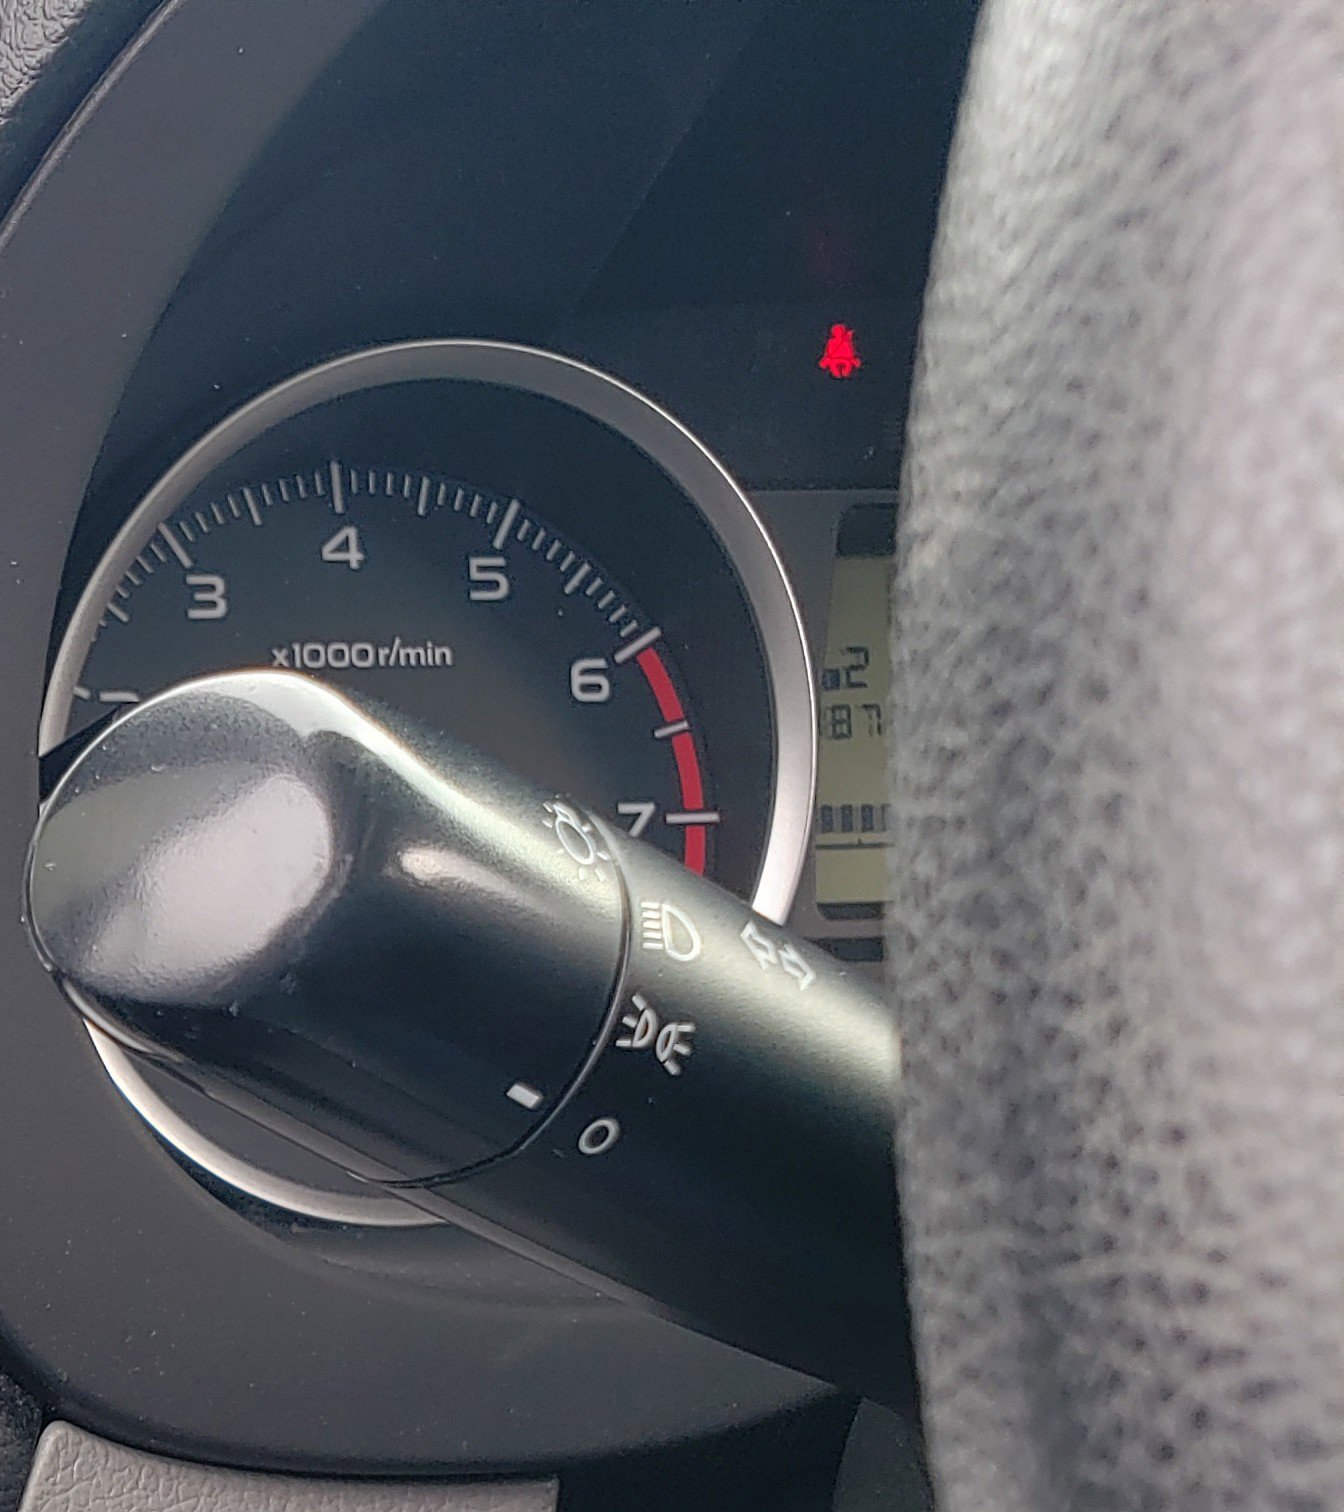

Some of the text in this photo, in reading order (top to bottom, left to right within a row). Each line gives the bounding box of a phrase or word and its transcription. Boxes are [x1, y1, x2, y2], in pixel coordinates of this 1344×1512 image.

[322, 527, 364, 570] 4
[187, 575, 227, 620] 3
[469, 557, 509, 600] 5
[570, 657, 610, 704] 6
[618, 802, 656, 838] 7
